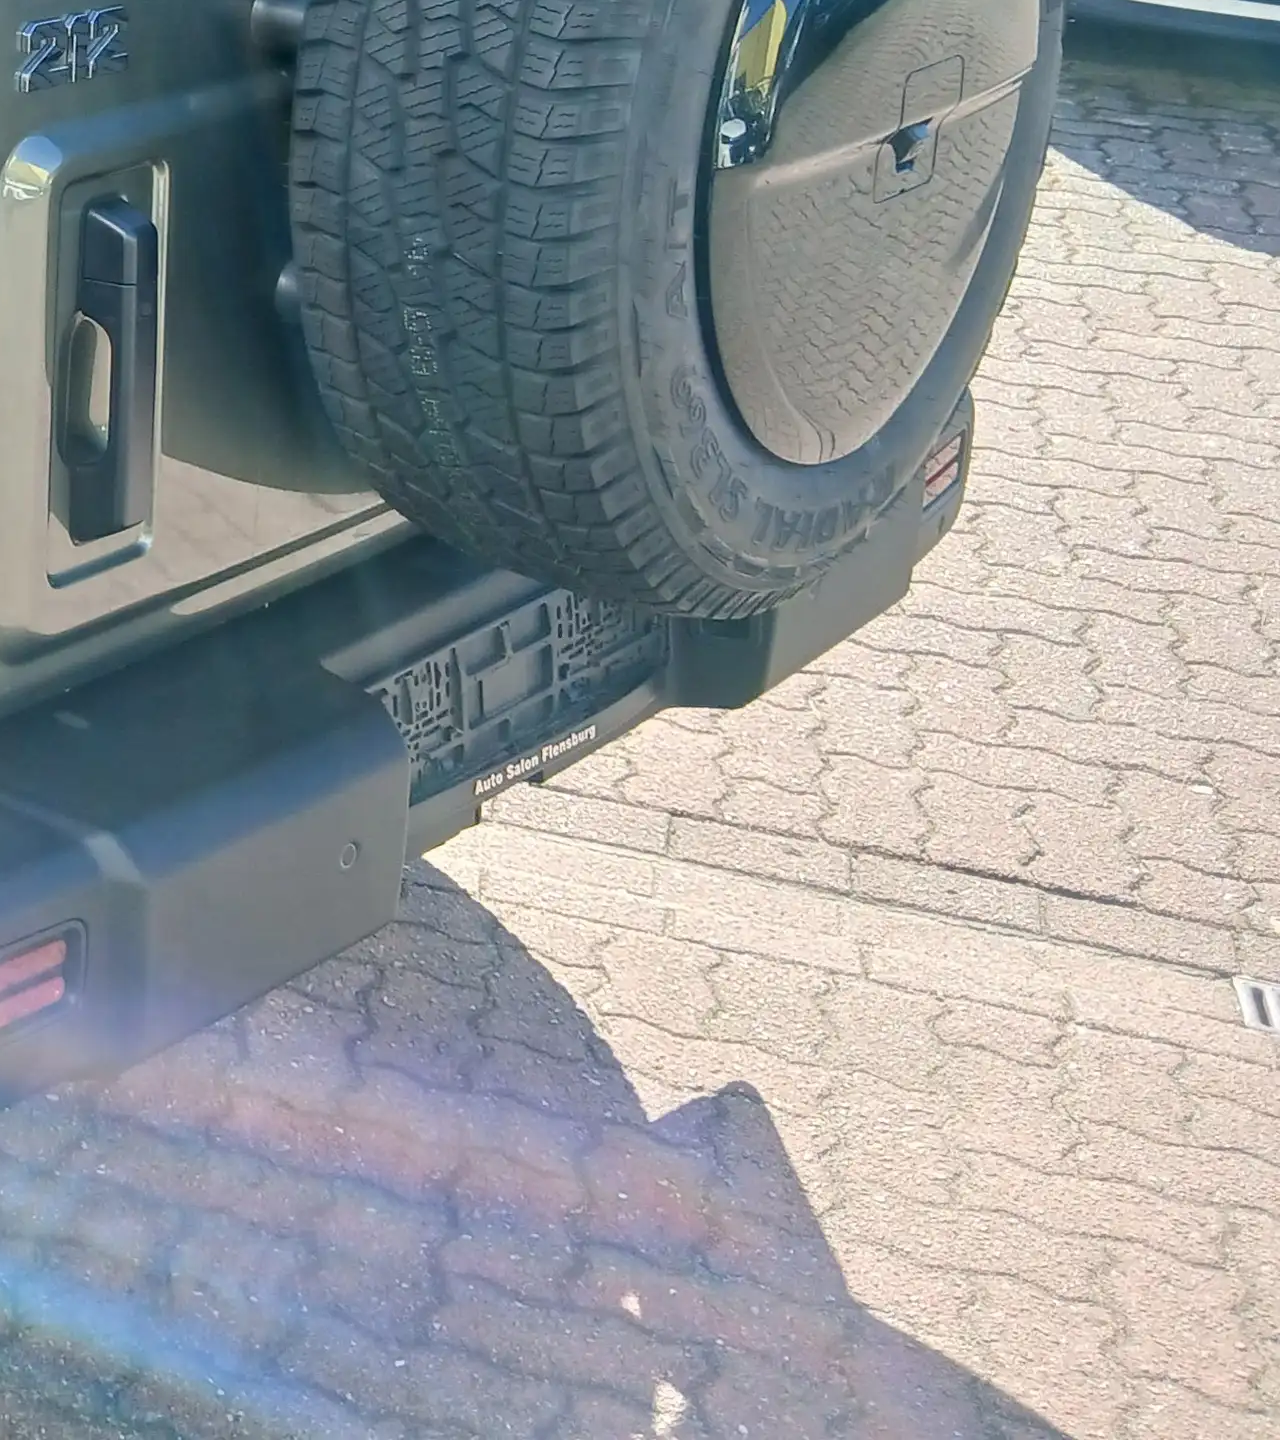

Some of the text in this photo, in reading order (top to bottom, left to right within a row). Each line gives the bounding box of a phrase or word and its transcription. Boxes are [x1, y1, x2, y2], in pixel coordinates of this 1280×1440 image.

[14, 5, 127, 93] 212
[474, 724, 597, 796] Auto Salon Flensburg
